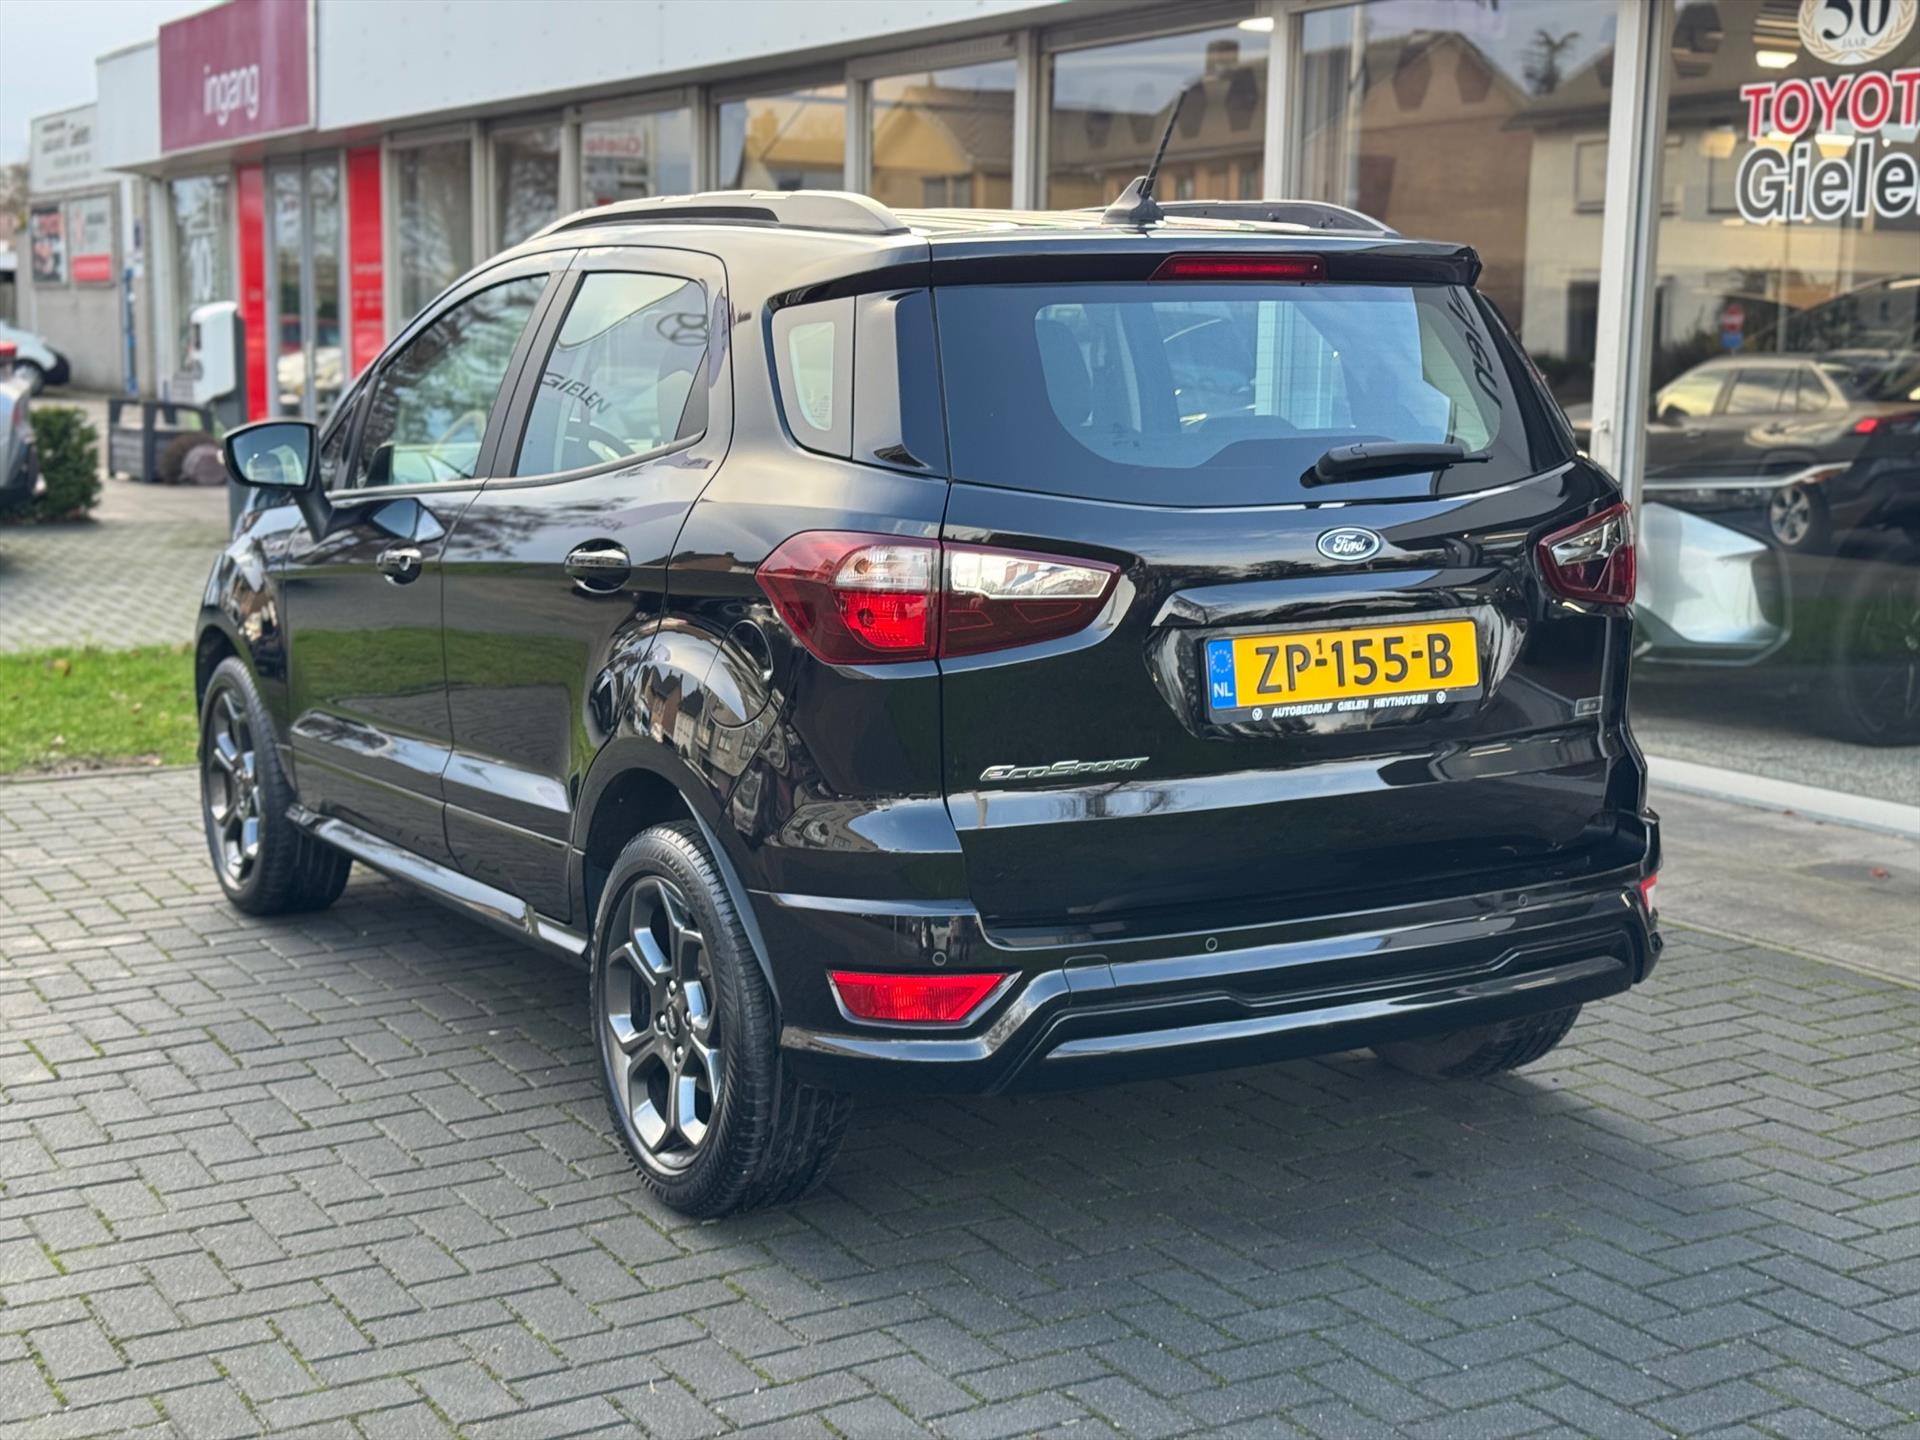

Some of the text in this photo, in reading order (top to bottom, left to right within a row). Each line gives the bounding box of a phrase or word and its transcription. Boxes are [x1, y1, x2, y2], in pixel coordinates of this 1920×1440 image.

[1842, 37, 1867, 48] JAAR
[203, 64, 260, 127] ingang
[1740, 67, 1920, 141] TOYOT
[1735, 137, 1920, 224] Giele
[1332, 534, 1366, 553] Ford
[1213, 682, 1234, 698] NL
[1272, 693, 1428, 718] AUTOBEDRIJF GIELEN HEYTHUYSEN
